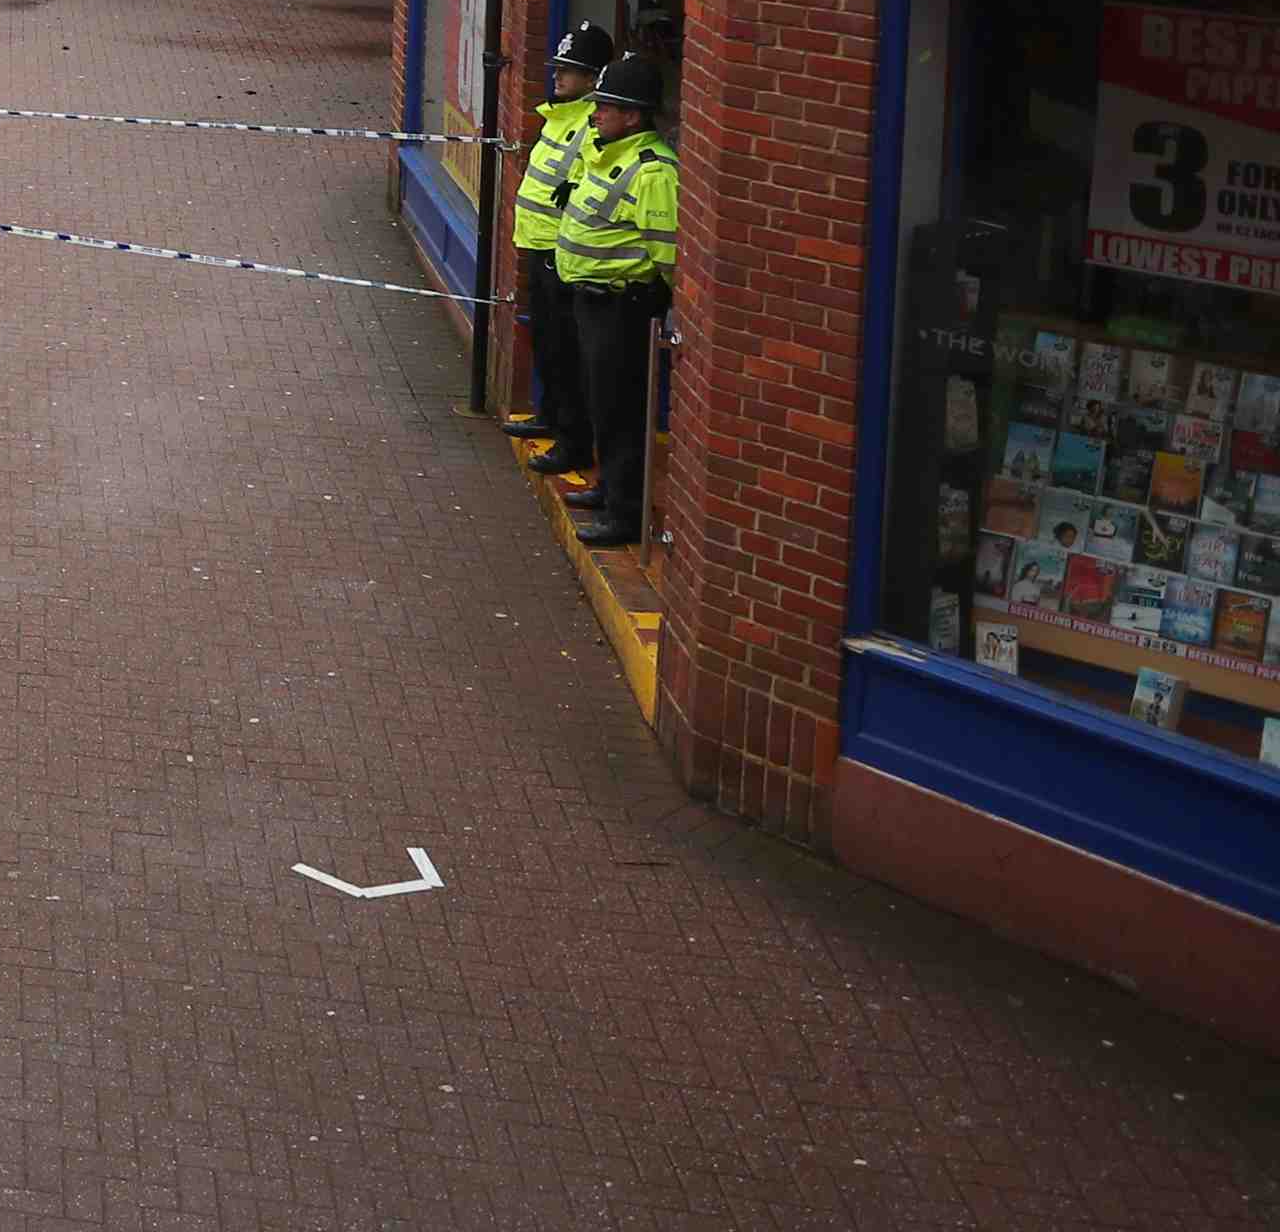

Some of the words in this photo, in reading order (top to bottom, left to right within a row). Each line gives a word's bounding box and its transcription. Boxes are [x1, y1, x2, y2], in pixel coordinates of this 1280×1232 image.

[1130, 121, 1207, 233] 3
[1227, 160, 1280, 192] FOR
[1092, 231, 1220, 281] LOWEST
[929, 327, 985, 356] THE
